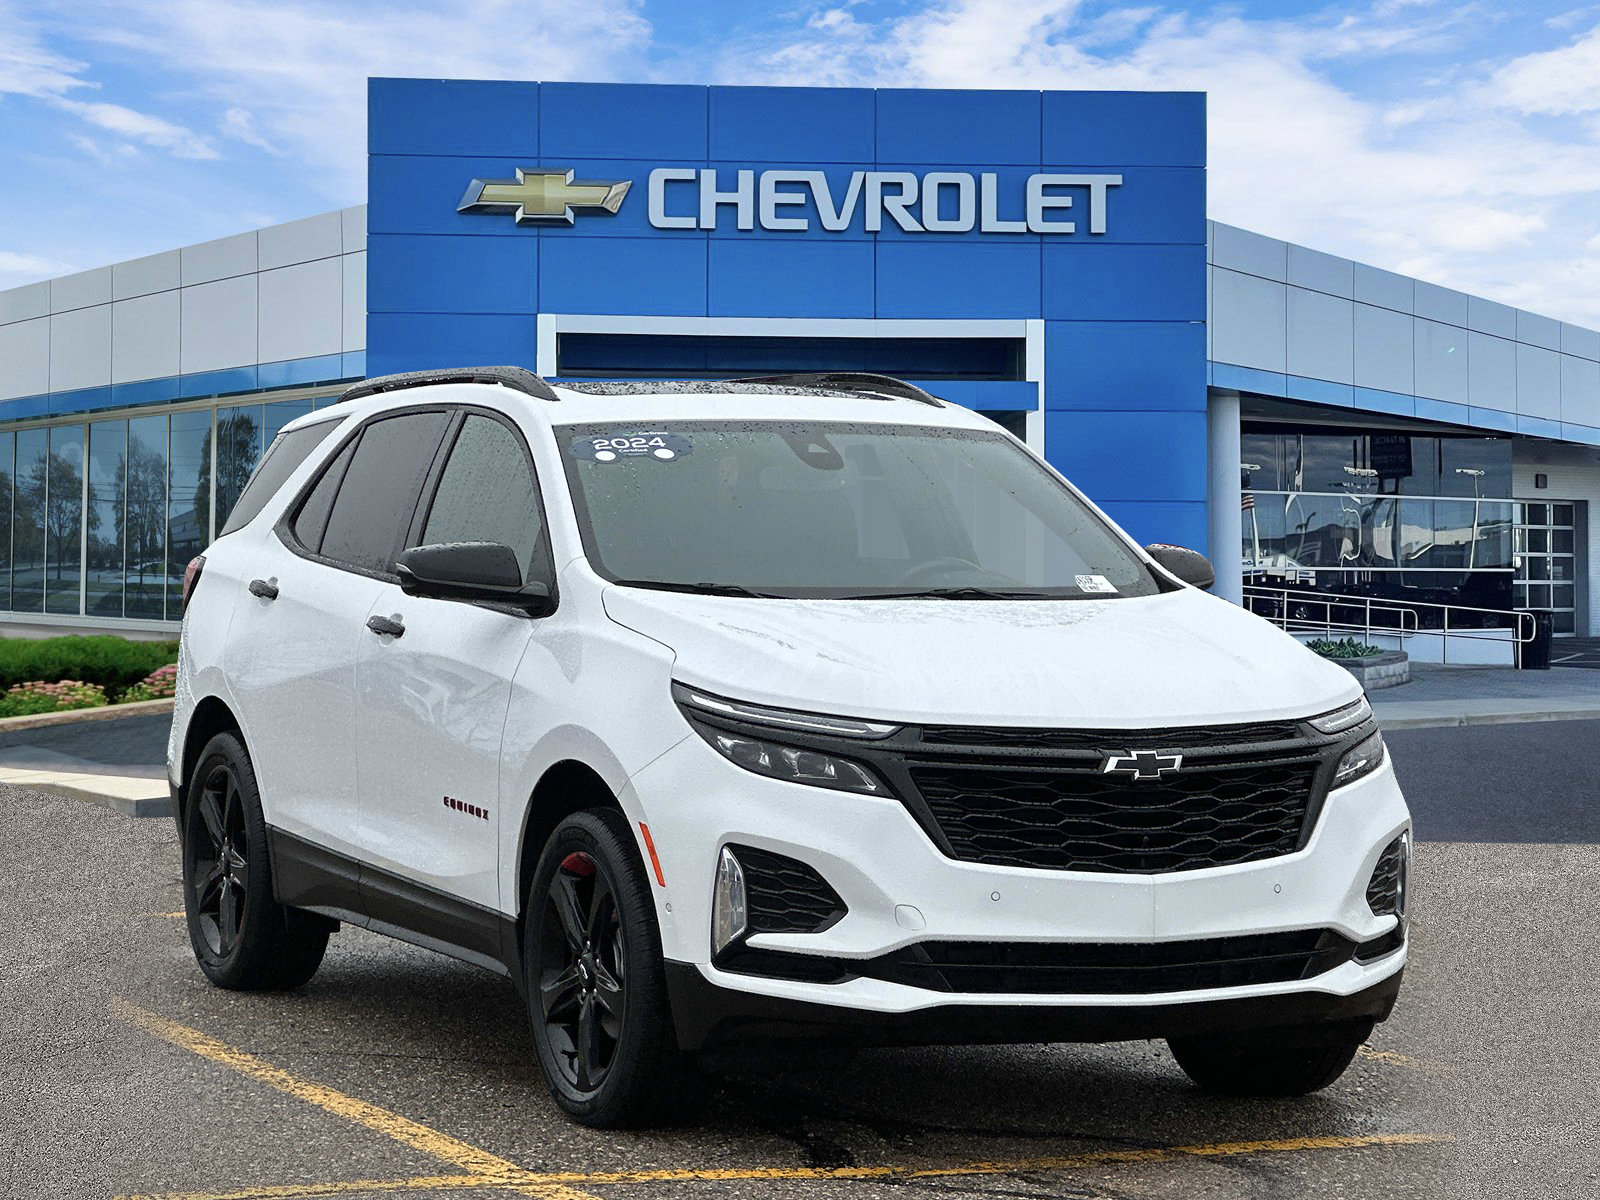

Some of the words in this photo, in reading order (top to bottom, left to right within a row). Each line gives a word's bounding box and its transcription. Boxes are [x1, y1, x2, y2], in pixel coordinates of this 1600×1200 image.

[648, 168, 1123, 233] CHEVROLET
[592, 437, 667, 450] 2024
[443, 796, 489, 820] EQUINOX
